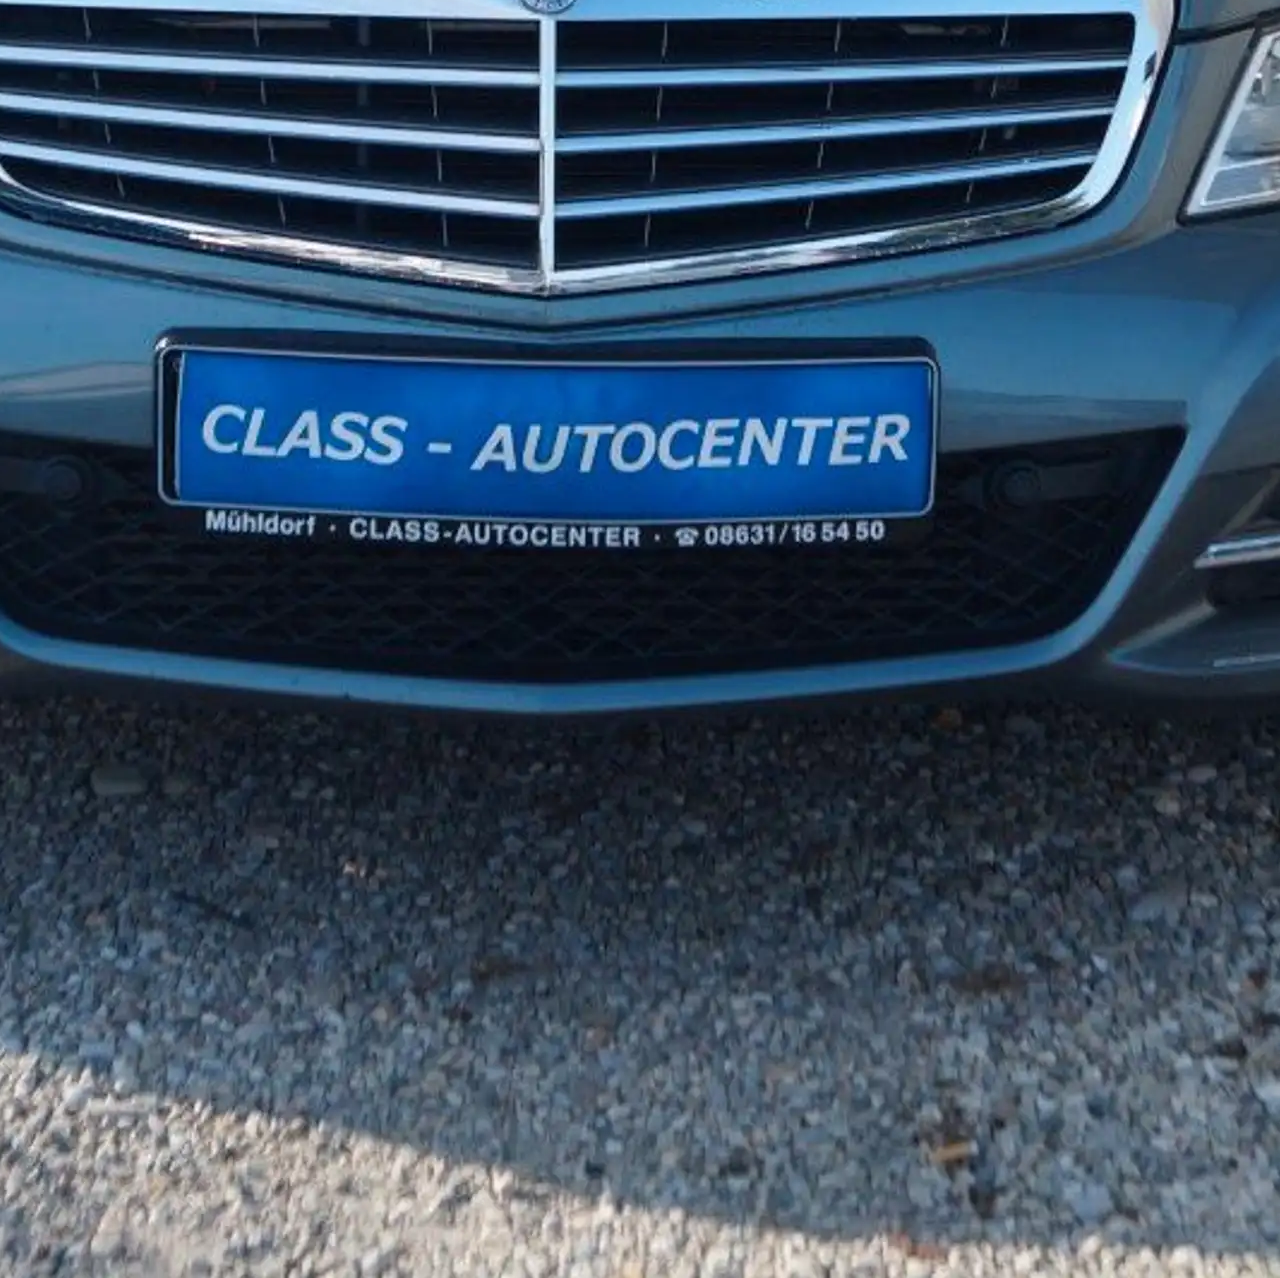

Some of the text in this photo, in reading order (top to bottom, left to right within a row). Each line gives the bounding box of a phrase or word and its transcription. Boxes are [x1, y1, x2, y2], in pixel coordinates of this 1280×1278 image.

[202, 404, 408, 465] CLASS
[470, 413, 911, 473] AUTOCENTER
[205, 509, 317, 536] Mühldorf
[349, 517, 640, 547] CLASS-AUTOCENTER
